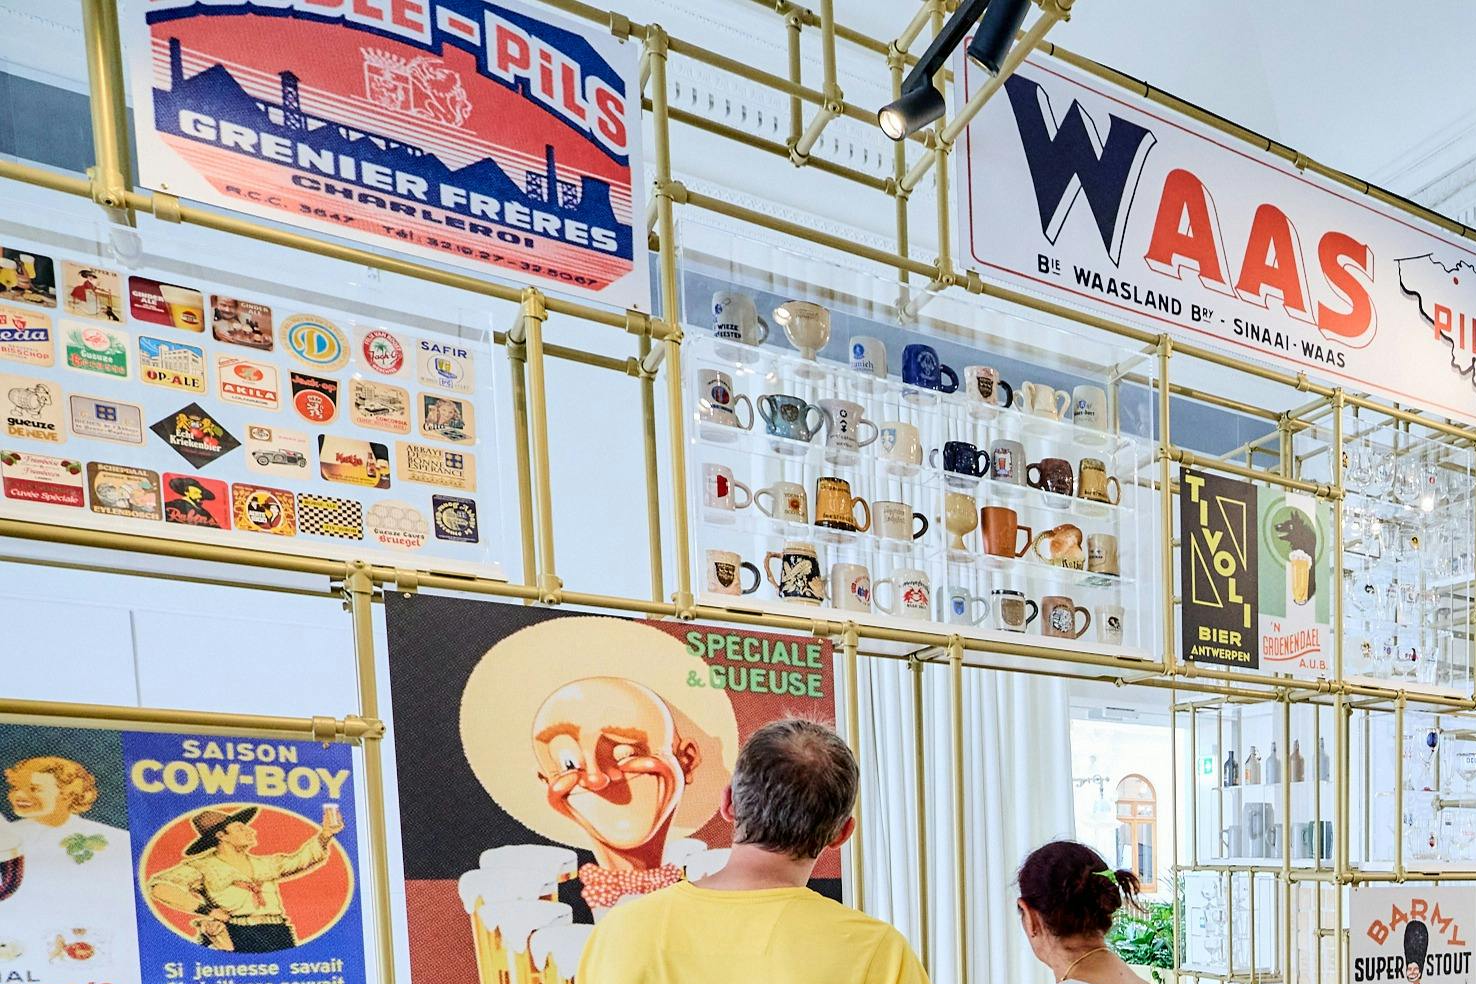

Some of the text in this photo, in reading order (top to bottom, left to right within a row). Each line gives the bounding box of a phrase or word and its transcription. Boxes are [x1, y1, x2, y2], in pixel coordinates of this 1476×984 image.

[179, 108, 618, 252] GRENIER FRÈRES
[291, 175, 535, 249] CHARLEROI
[1004, 72, 1376, 349] WAAS
[131, 290, 165, 303] GINDER
[1073, 265, 1182, 316] WAASLAND
[0, 329, 48, 341] eda
[421, 341, 468, 359] SAFIR
[223, 384, 277, 400] AKILA
[7, 417, 56, 430] gueuze
[175, 429, 196, 439] Echt
[169, 434, 222, 452] Kriekenbier
[407, 456, 445, 468] BONNE
[93, 505, 160, 520] EYLENBOSCH
[378, 535, 421, 547] Bruegel
[1185, 475, 1252, 629] TIVOLI
[1198, 625, 1242, 647] BIER
[1262, 628, 1321, 656] GROENENDAEL
[1190, 644, 1251, 662] ANTWERPEN
[1298, 658, 1329, 670] A.U.B.
[686, 664, 824, 698] & GUEUSE
[182, 740, 298, 763] SAISON
[131, 759, 349, 800] COW-BOY
[1366, 898, 1466, 946] BARMY
[165, 958, 344, 980] Si jeunesse savait
[1354, 951, 1472, 983] SUPER STOUT
